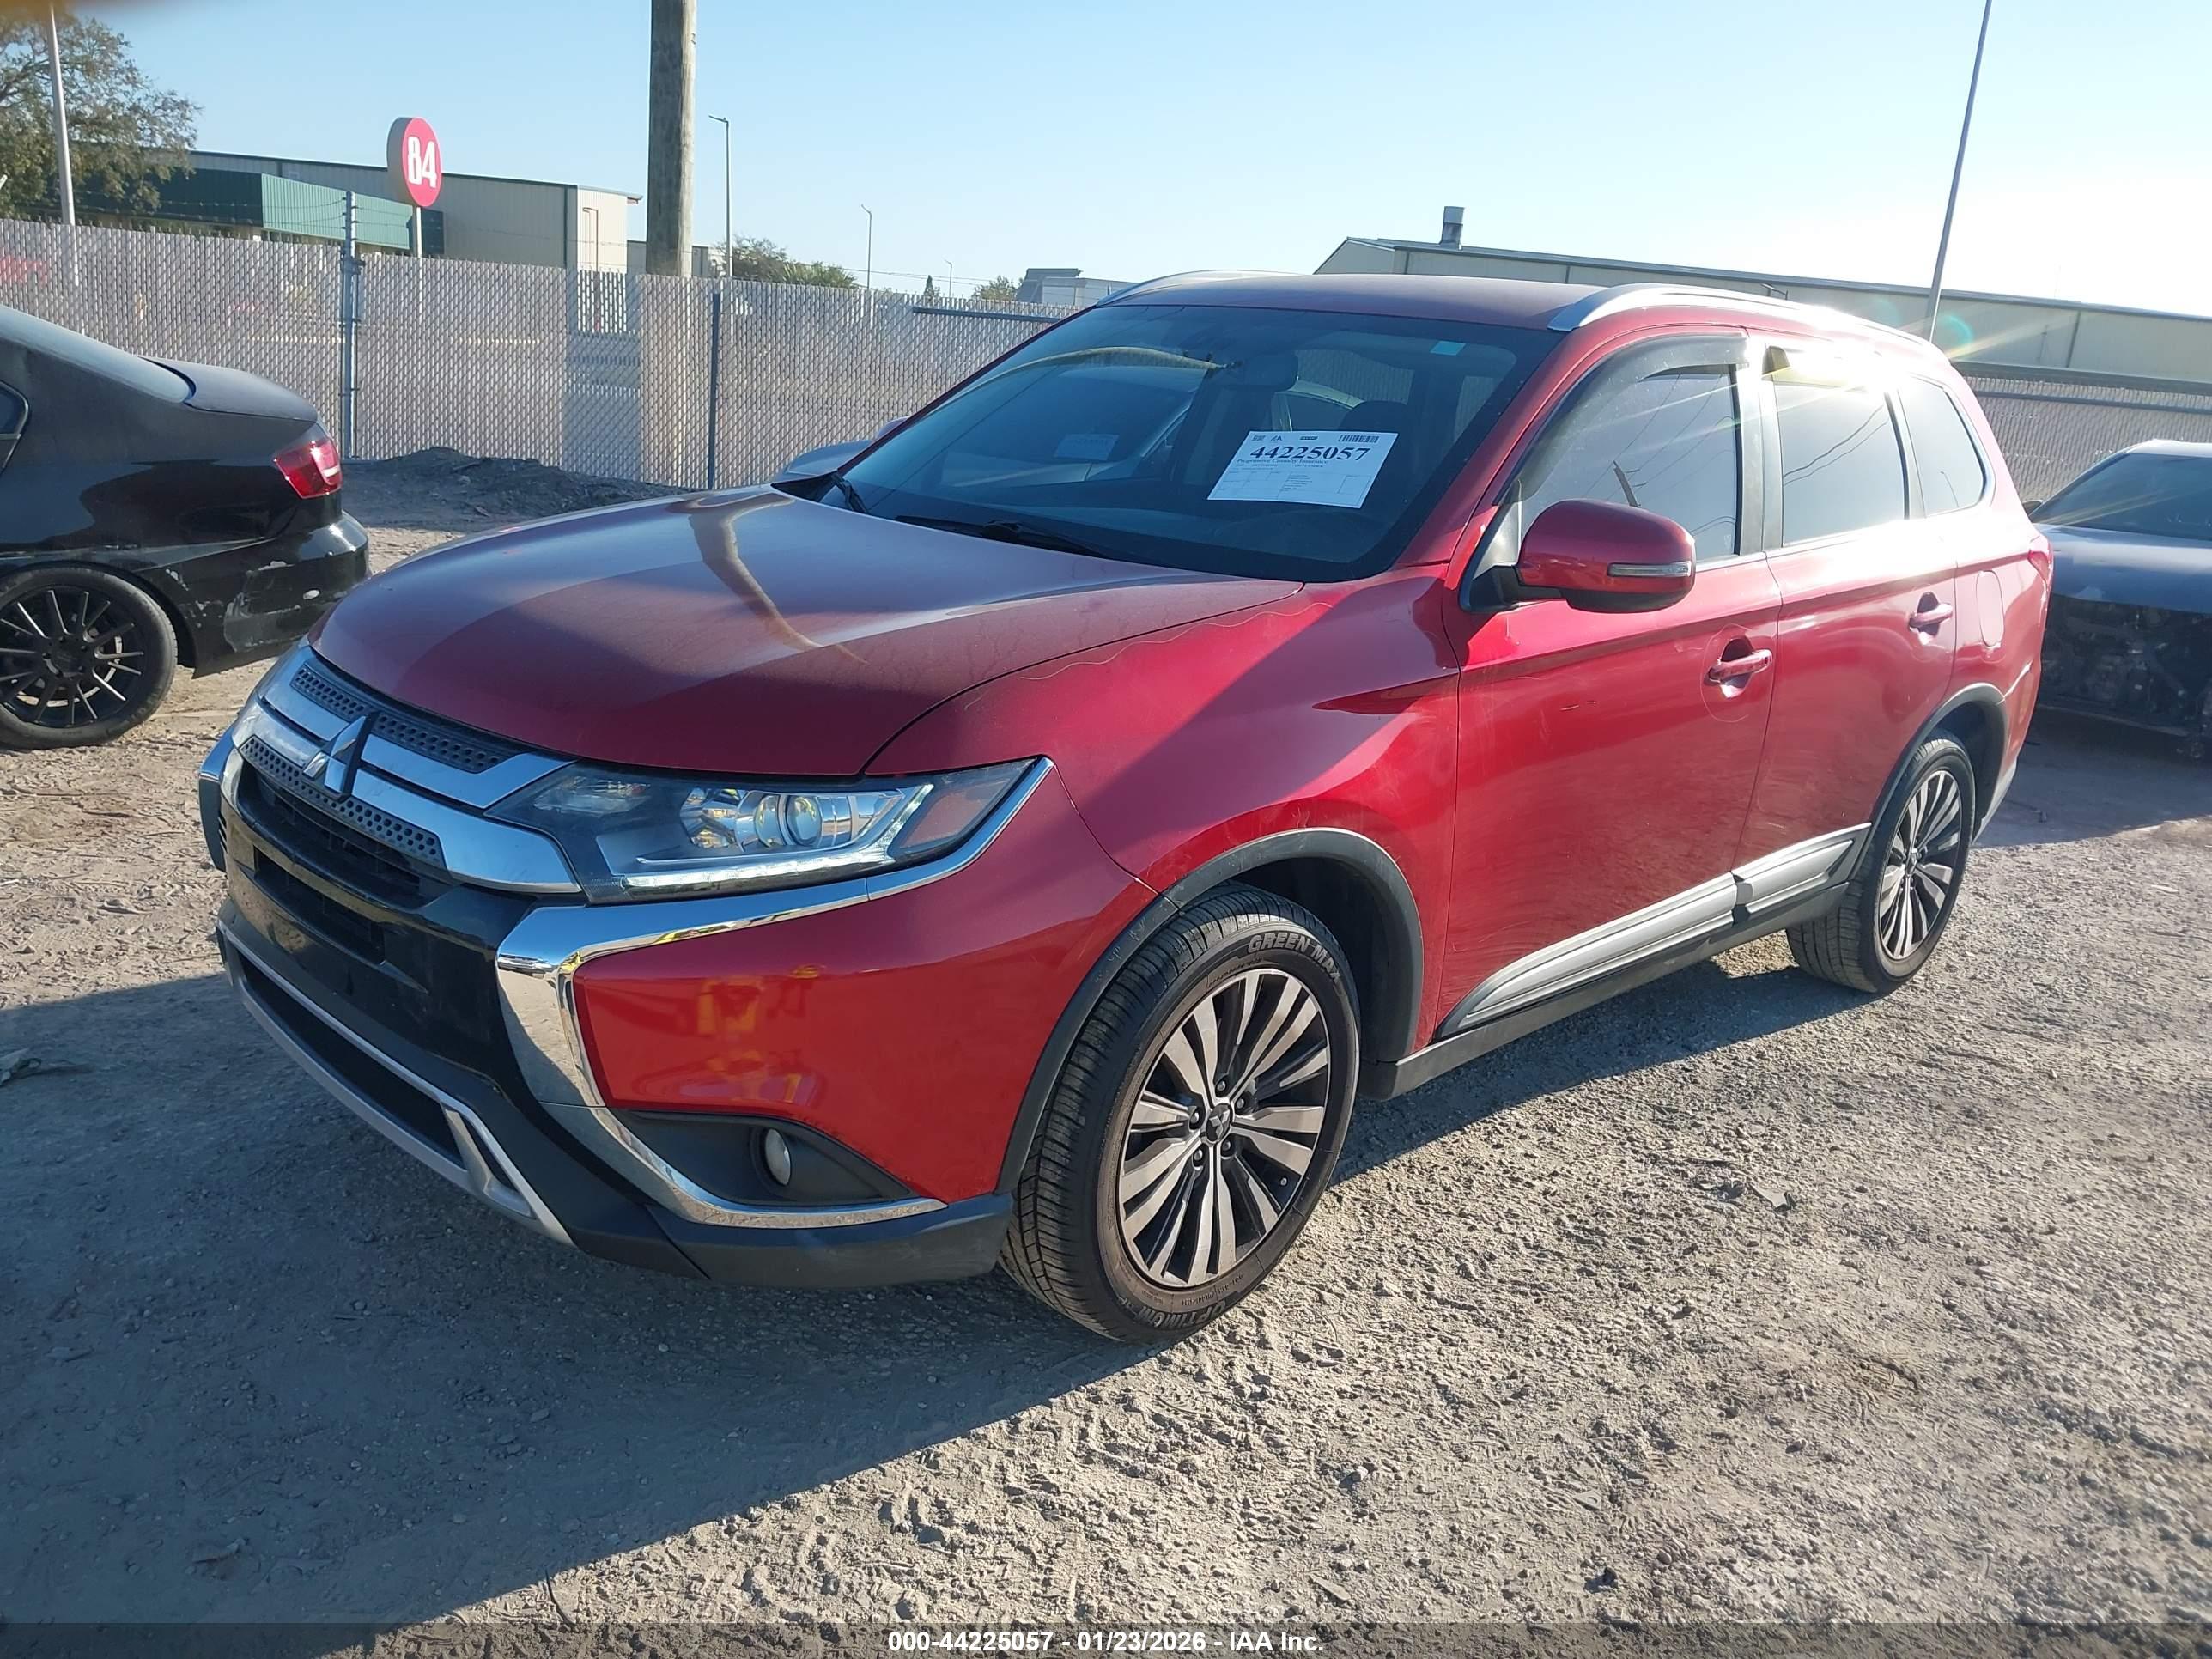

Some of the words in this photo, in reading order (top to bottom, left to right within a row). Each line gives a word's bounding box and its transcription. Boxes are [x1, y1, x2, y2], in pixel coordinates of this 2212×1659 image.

[408, 136, 437, 188] 84
[1250, 446, 1370, 460] 44225057
[1248, 932, 1310, 953] GREEN
